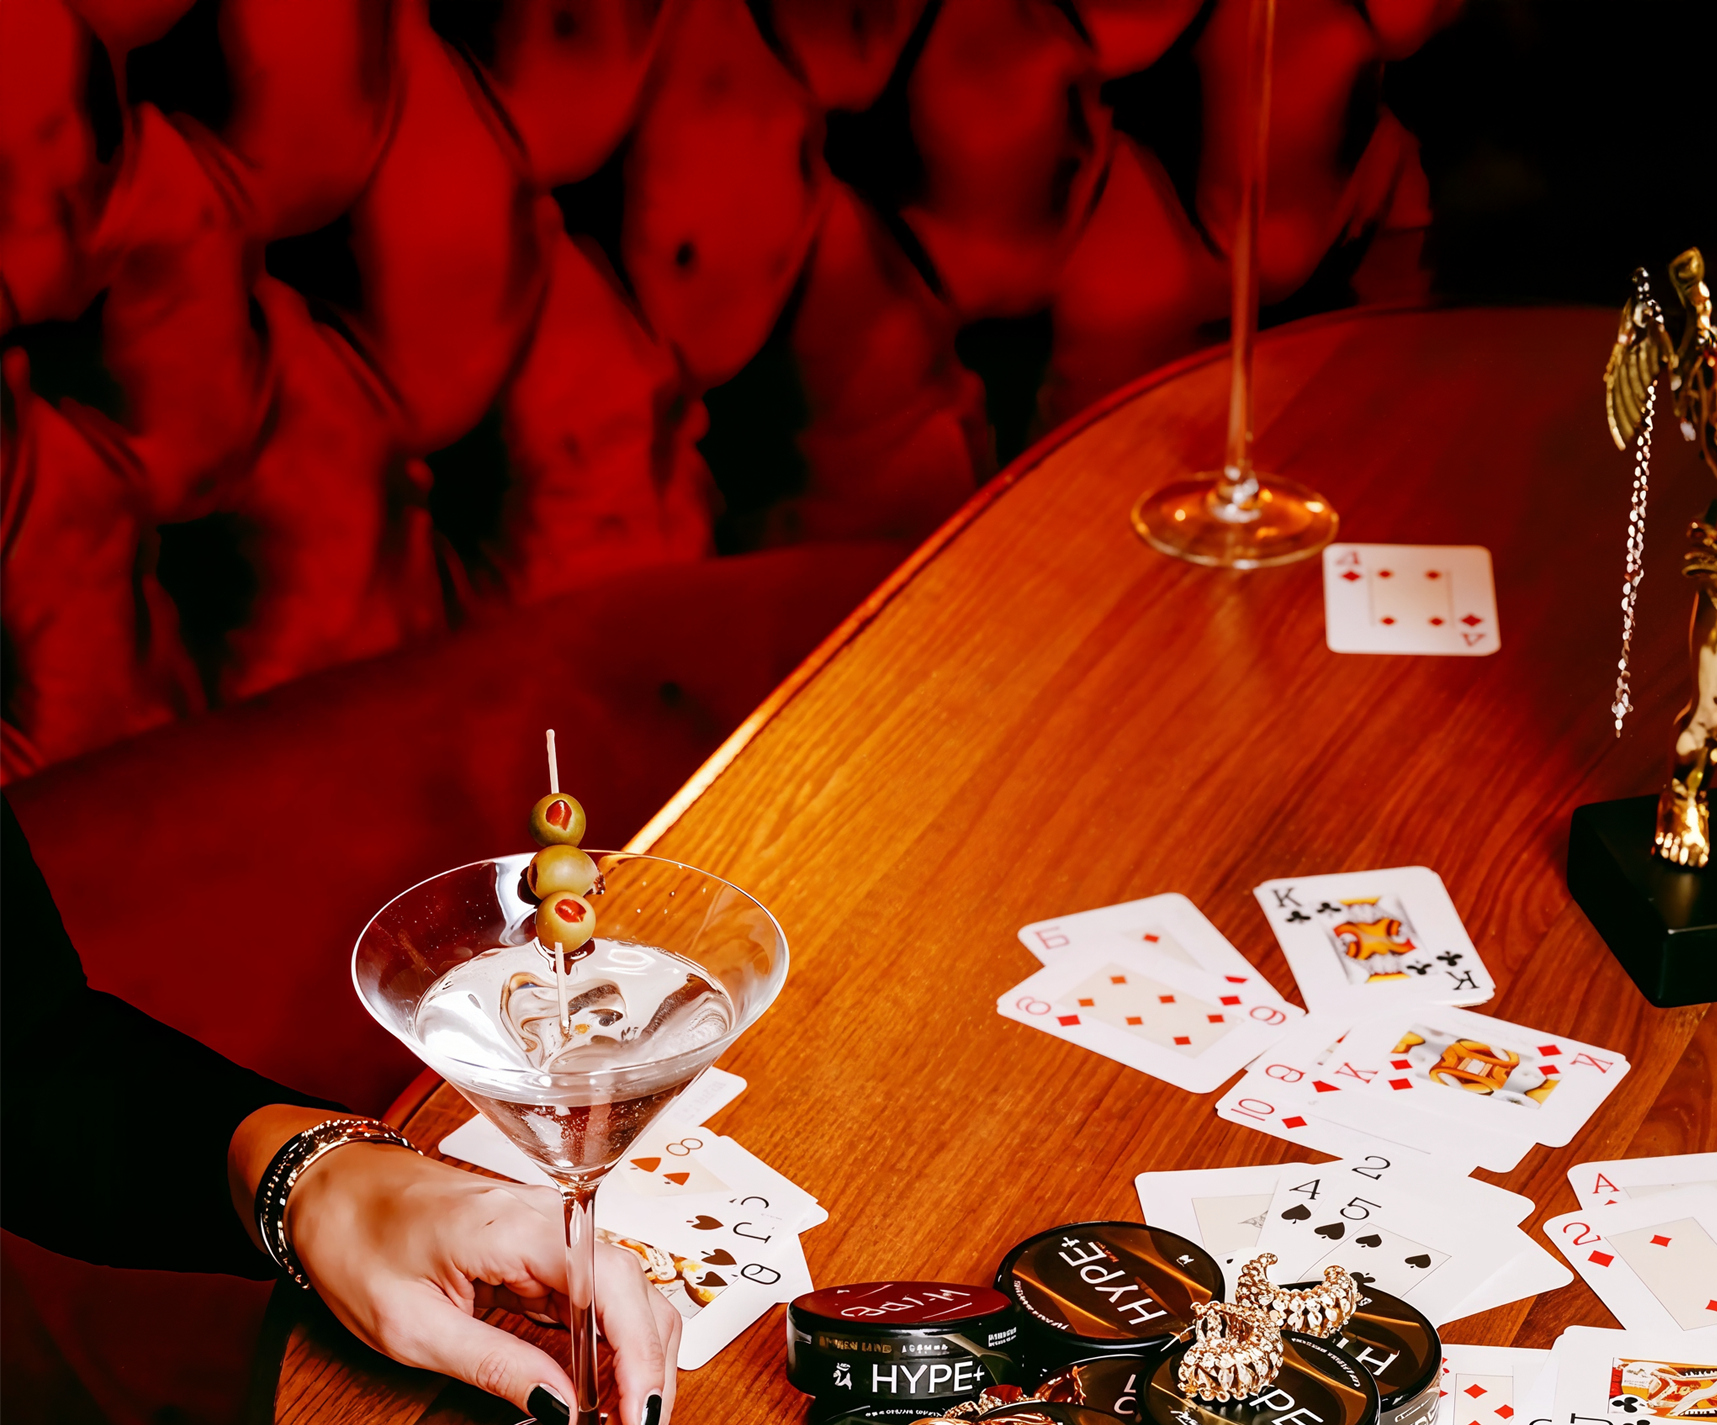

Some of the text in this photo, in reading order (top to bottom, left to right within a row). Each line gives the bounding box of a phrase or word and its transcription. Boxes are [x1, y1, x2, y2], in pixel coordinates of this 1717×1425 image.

[1271, 886, 1303, 908] K
[1446, 969, 1481, 991] K
[1333, 1062, 1380, 1085] K
[1570, 1052, 1614, 1074] K
[1230, 1097, 1276, 1122] 10
[665, 1137, 704, 1157] 8
[1351, 1155, 1392, 1181] 2
[1288, 1178, 1322, 1201] 4
[1592, 1172, 1621, 1195] A
[1339, 1196, 1383, 1222] 5
[732, 1221, 772, 1244] J
[1562, 1221, 1602, 1246] 2
[1058, 1236, 1168, 1326] HYPE+
[871, 1360, 986, 1395] HYPE+
